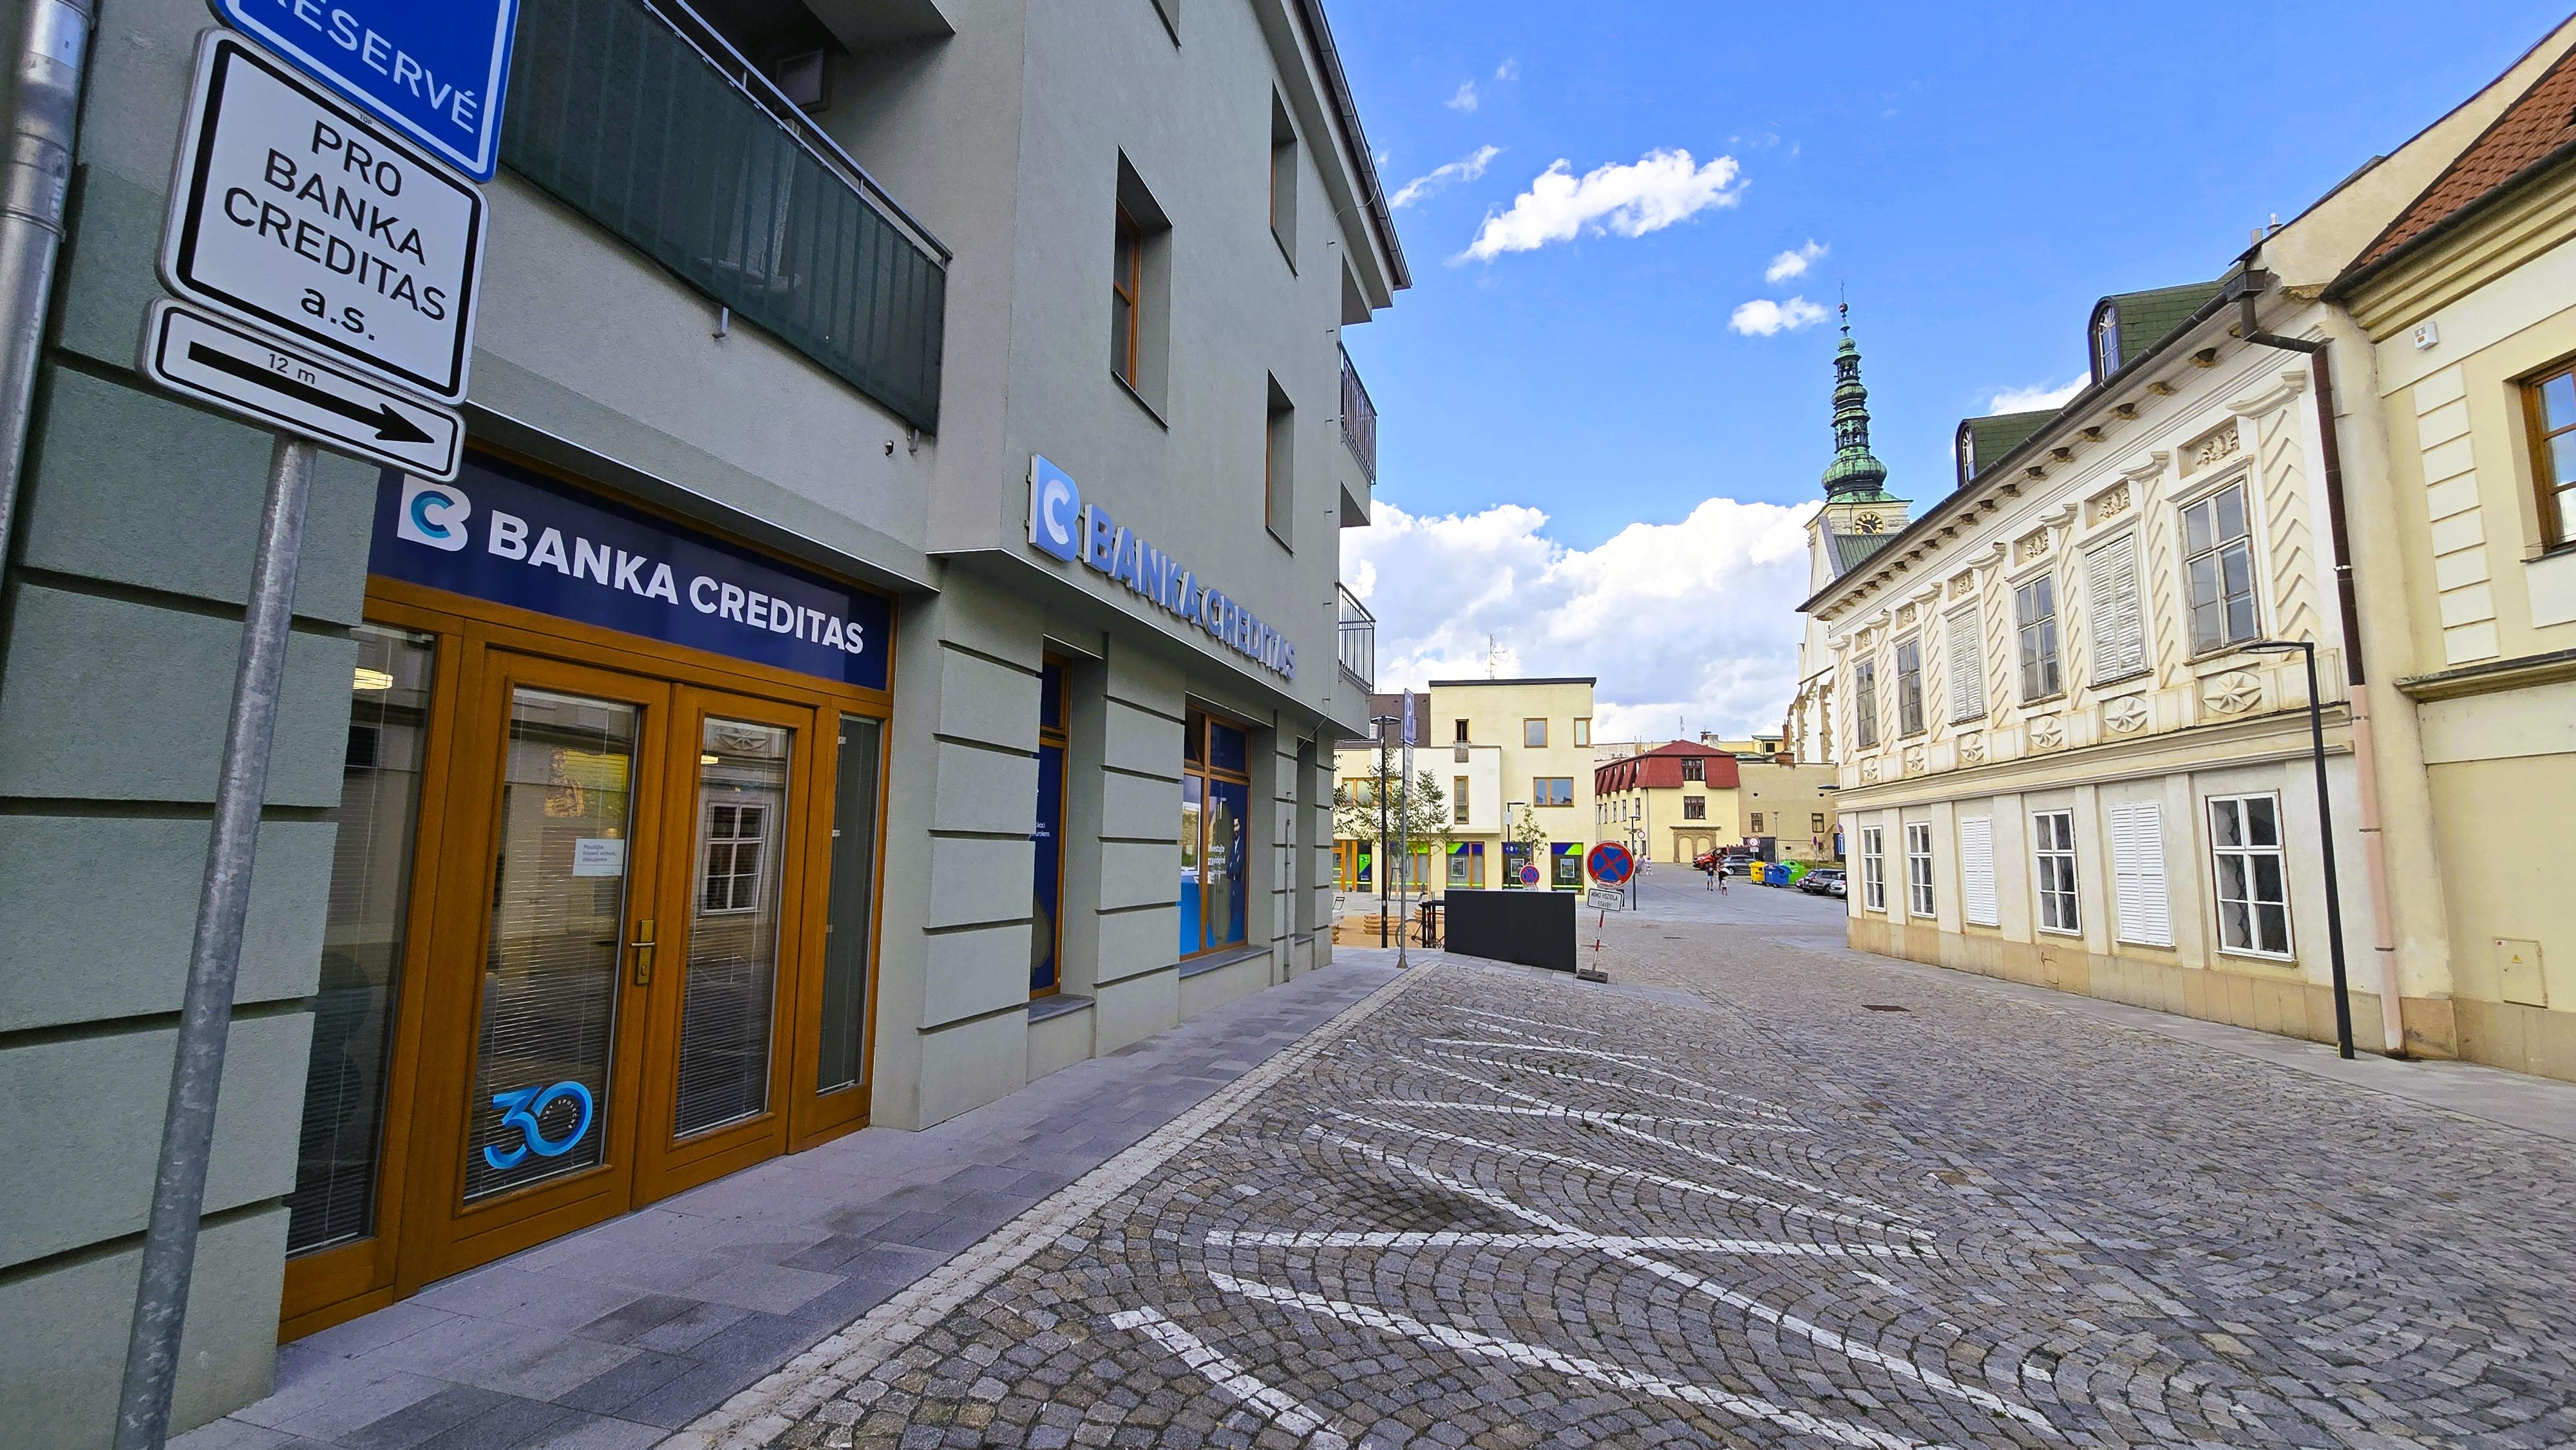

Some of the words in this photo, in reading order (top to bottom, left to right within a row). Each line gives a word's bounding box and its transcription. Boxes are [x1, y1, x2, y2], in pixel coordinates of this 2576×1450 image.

[277, 0, 477, 133] ESERVÉ
[263, 147, 426, 265] BANKA
[310, 120, 402, 197] PRO
[223, 187, 446, 321] CREDITAS
[300, 287, 377, 341] a.s.
[267, 353, 289, 374] 12
[297, 368, 316, 385] m
[488, 509, 679, 605] BANKA
[688, 575, 865, 655] CREDITAS
[1083, 504, 1202, 626] BANKA
[1202, 587, 1297, 680] CREDITAS
[1406, 697, 1412, 727] P
[484, 1080, 594, 1170] 30
